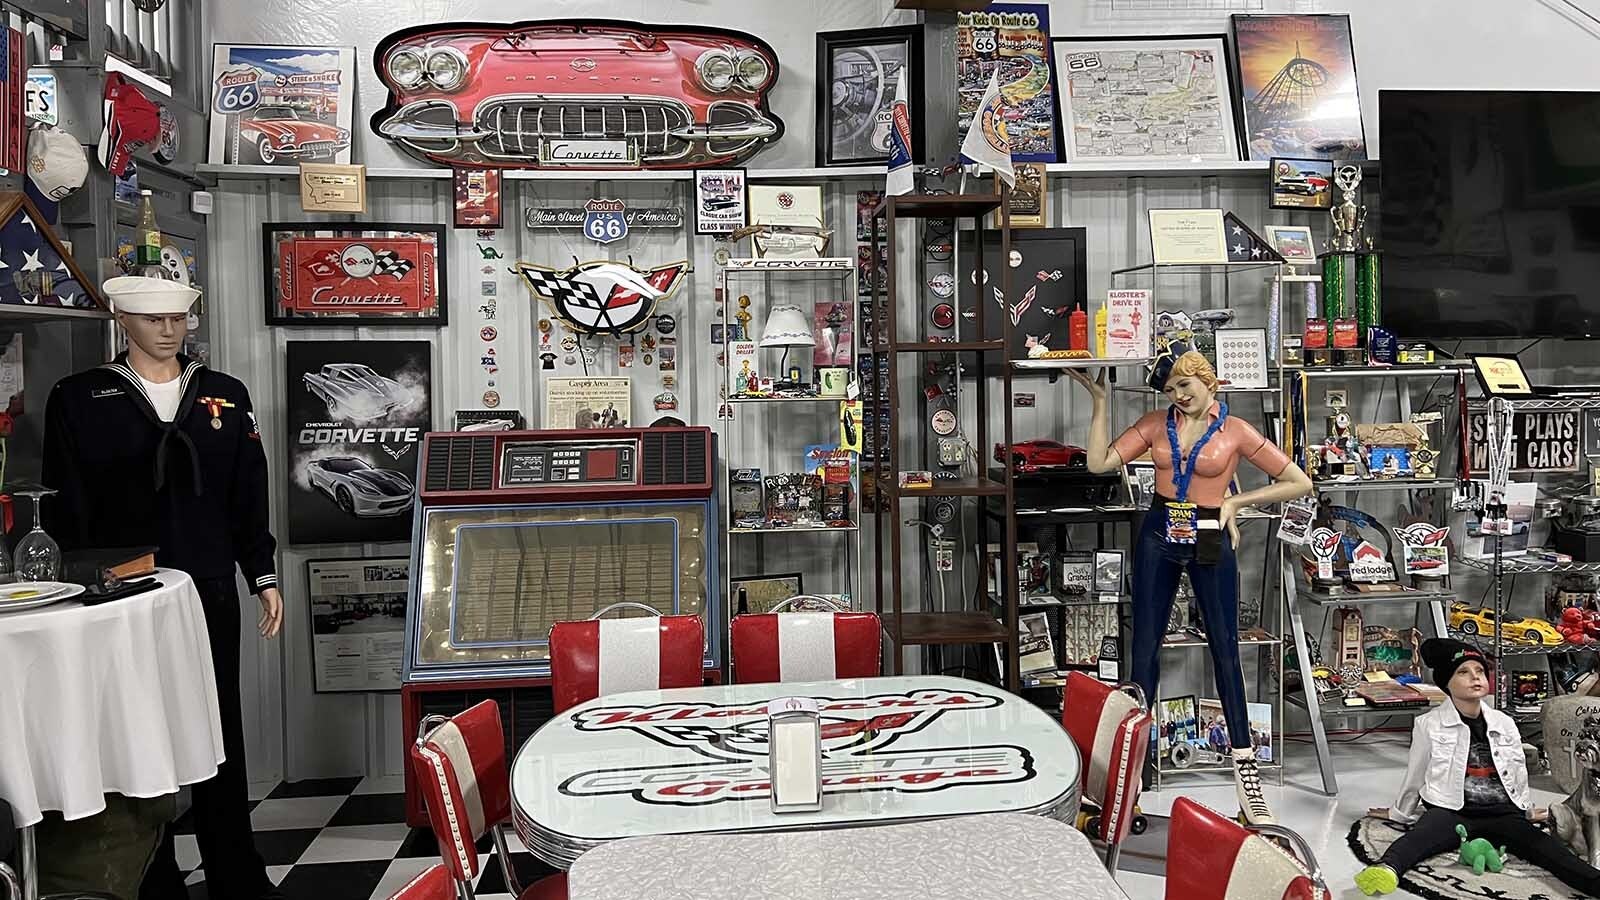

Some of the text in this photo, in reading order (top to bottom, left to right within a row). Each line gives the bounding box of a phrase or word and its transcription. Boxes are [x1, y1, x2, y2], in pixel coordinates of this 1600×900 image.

[991, 15, 1000, 26] On
[1001, 15, 1021, 26] Route
[1021, 16, 1036, 27] 66
[975, 39, 994, 51] 66
[1070, 57, 1098, 69] 66
[226, 75, 254, 85] ROUTE
[223, 86, 254, 109] 66
[551, 143, 624, 160] Corvette
[590, 203, 620, 211] ROUTE
[529, 210, 585, 223] Main Street
[626, 210, 678, 224] of America
[590, 219, 621, 239] 66
[700, 223, 743, 231] CLASS WINNER
[753, 260, 849, 268] CORVETTE
[311, 286, 405, 305] Corvette
[568, 380, 592, 388] Casper
[1525, 413, 1574, 440] PLAYS
[298, 427, 420, 444] CORVETTE
[1527, 441, 1573, 468] CARS
[1168, 509, 1192, 518] SPAM
